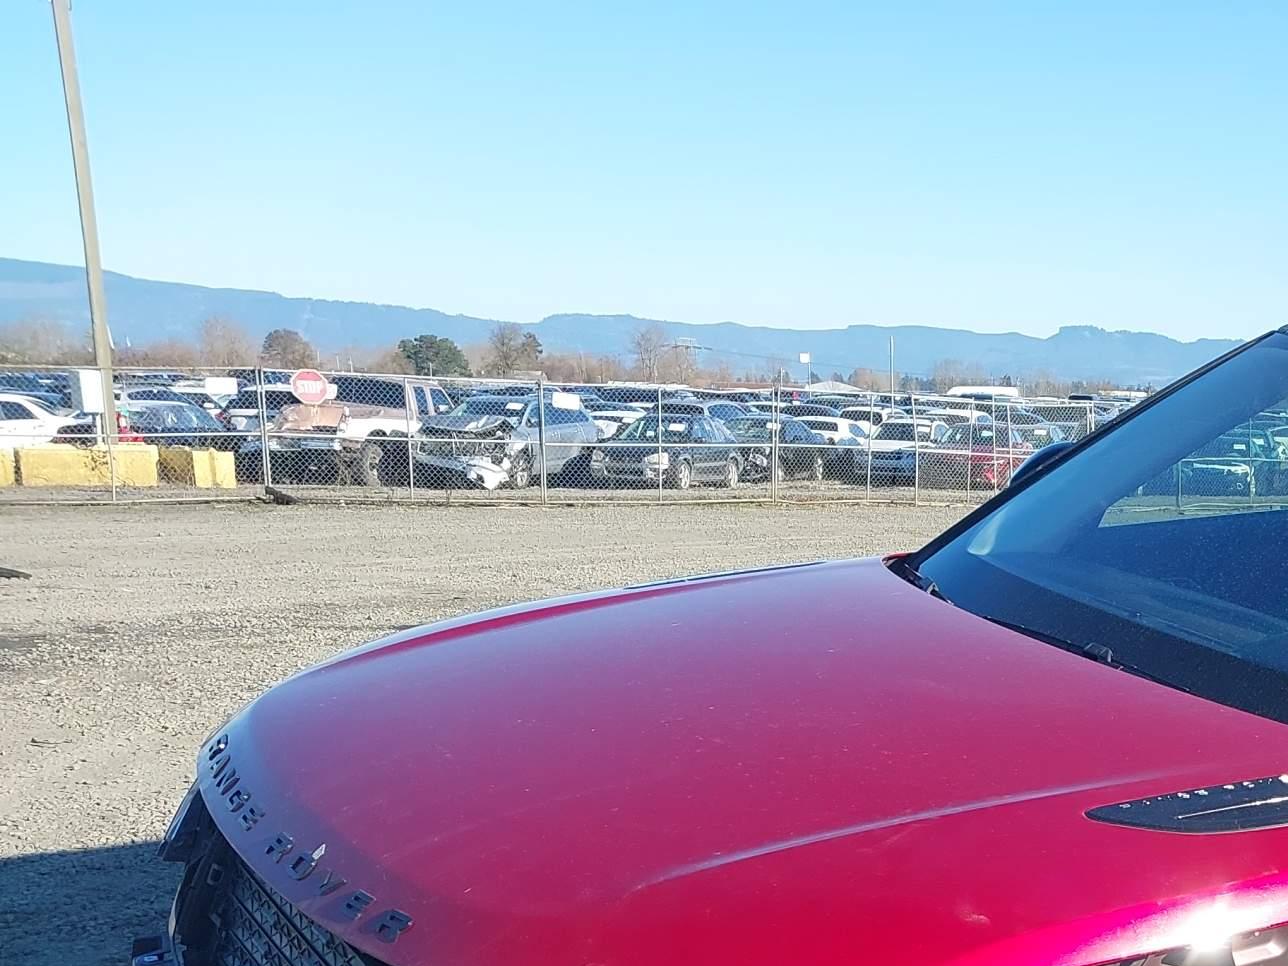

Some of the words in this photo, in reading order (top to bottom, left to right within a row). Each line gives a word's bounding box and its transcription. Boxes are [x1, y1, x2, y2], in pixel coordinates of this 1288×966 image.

[296, 380, 323, 394] STOP
[208, 734, 266, 832] RANGE
[265, 832, 414, 944] ROVER
